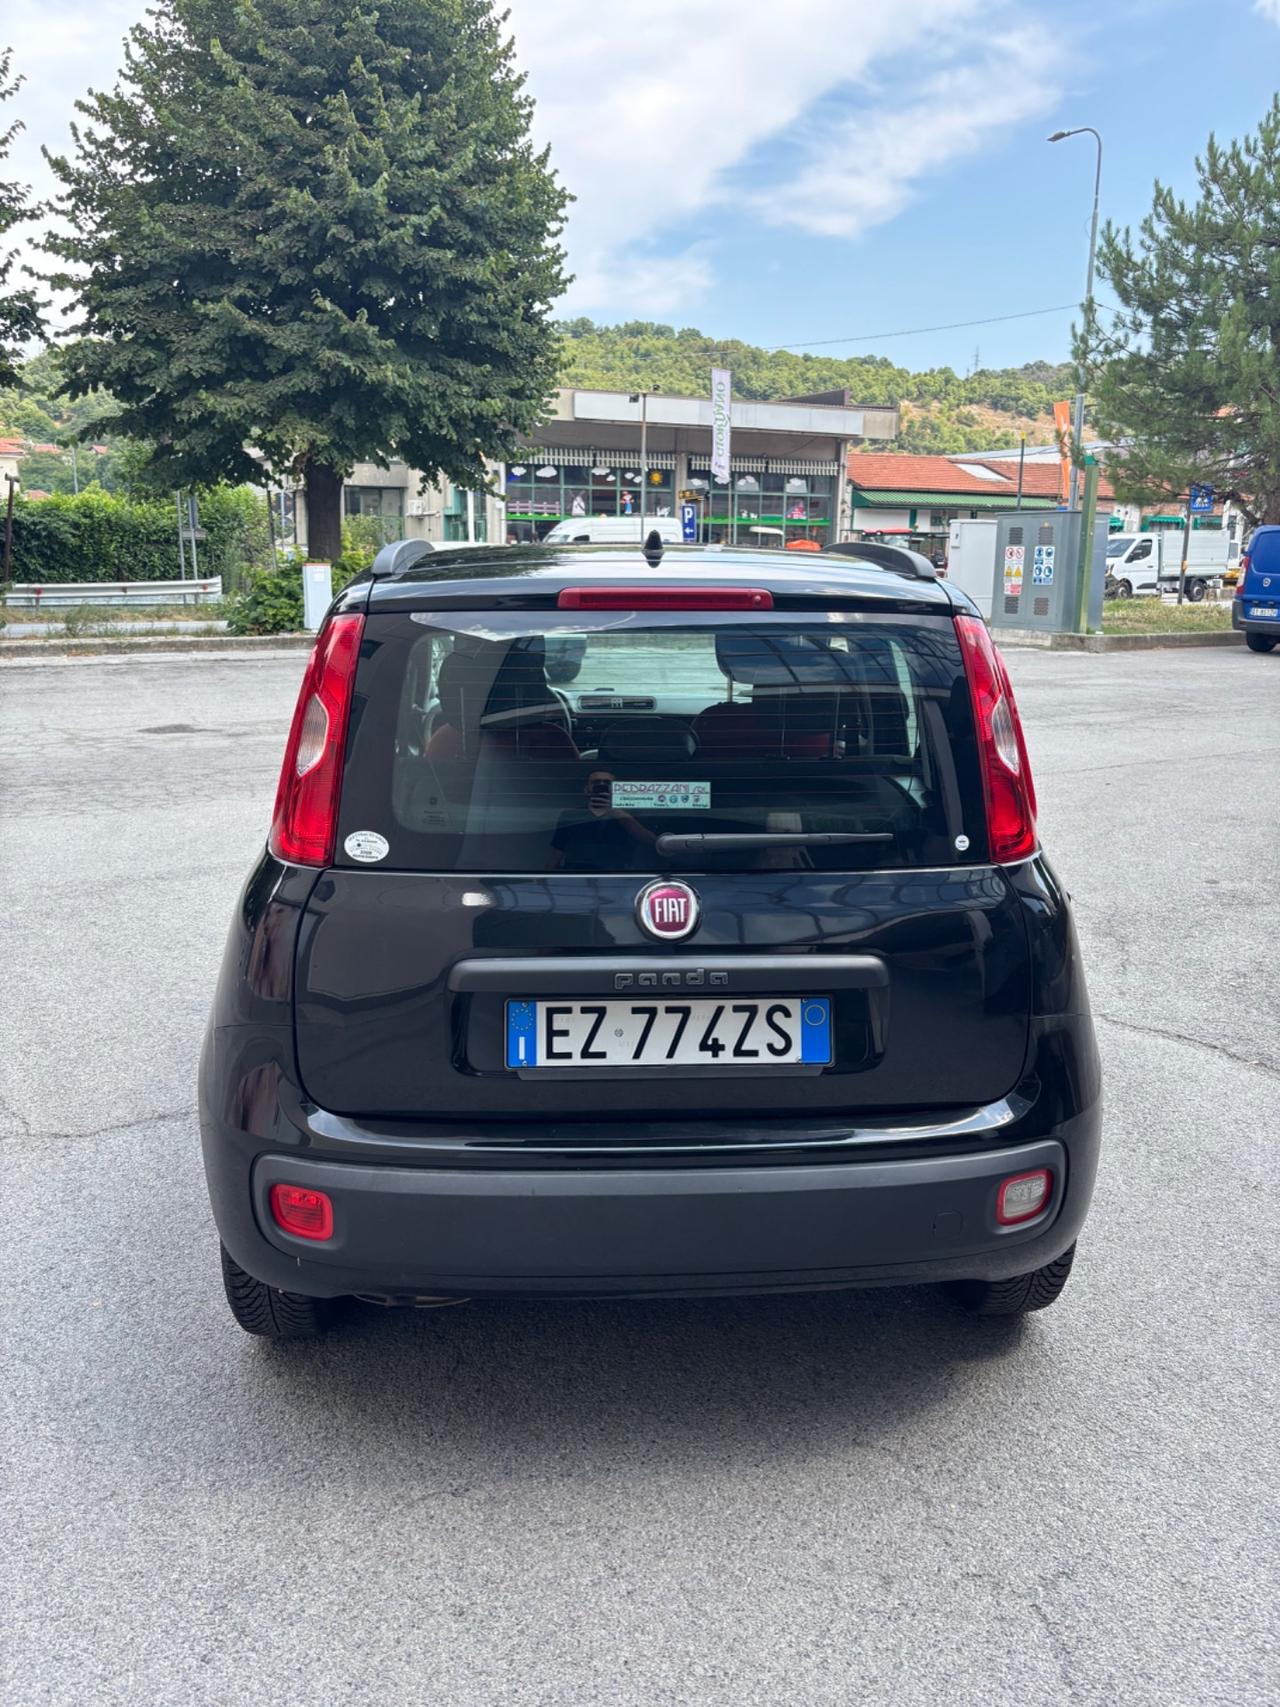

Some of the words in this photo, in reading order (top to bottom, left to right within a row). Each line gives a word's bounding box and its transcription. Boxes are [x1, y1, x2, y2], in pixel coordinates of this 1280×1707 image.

[684, 507, 693, 524] P
[654, 898, 687, 923] FIAT
[615, 969, 728, 990] panda
[546, 1005, 607, 1060] EZ
[631, 1004, 793, 1060] 774ZS
[518, 1036, 525, 1060] I
